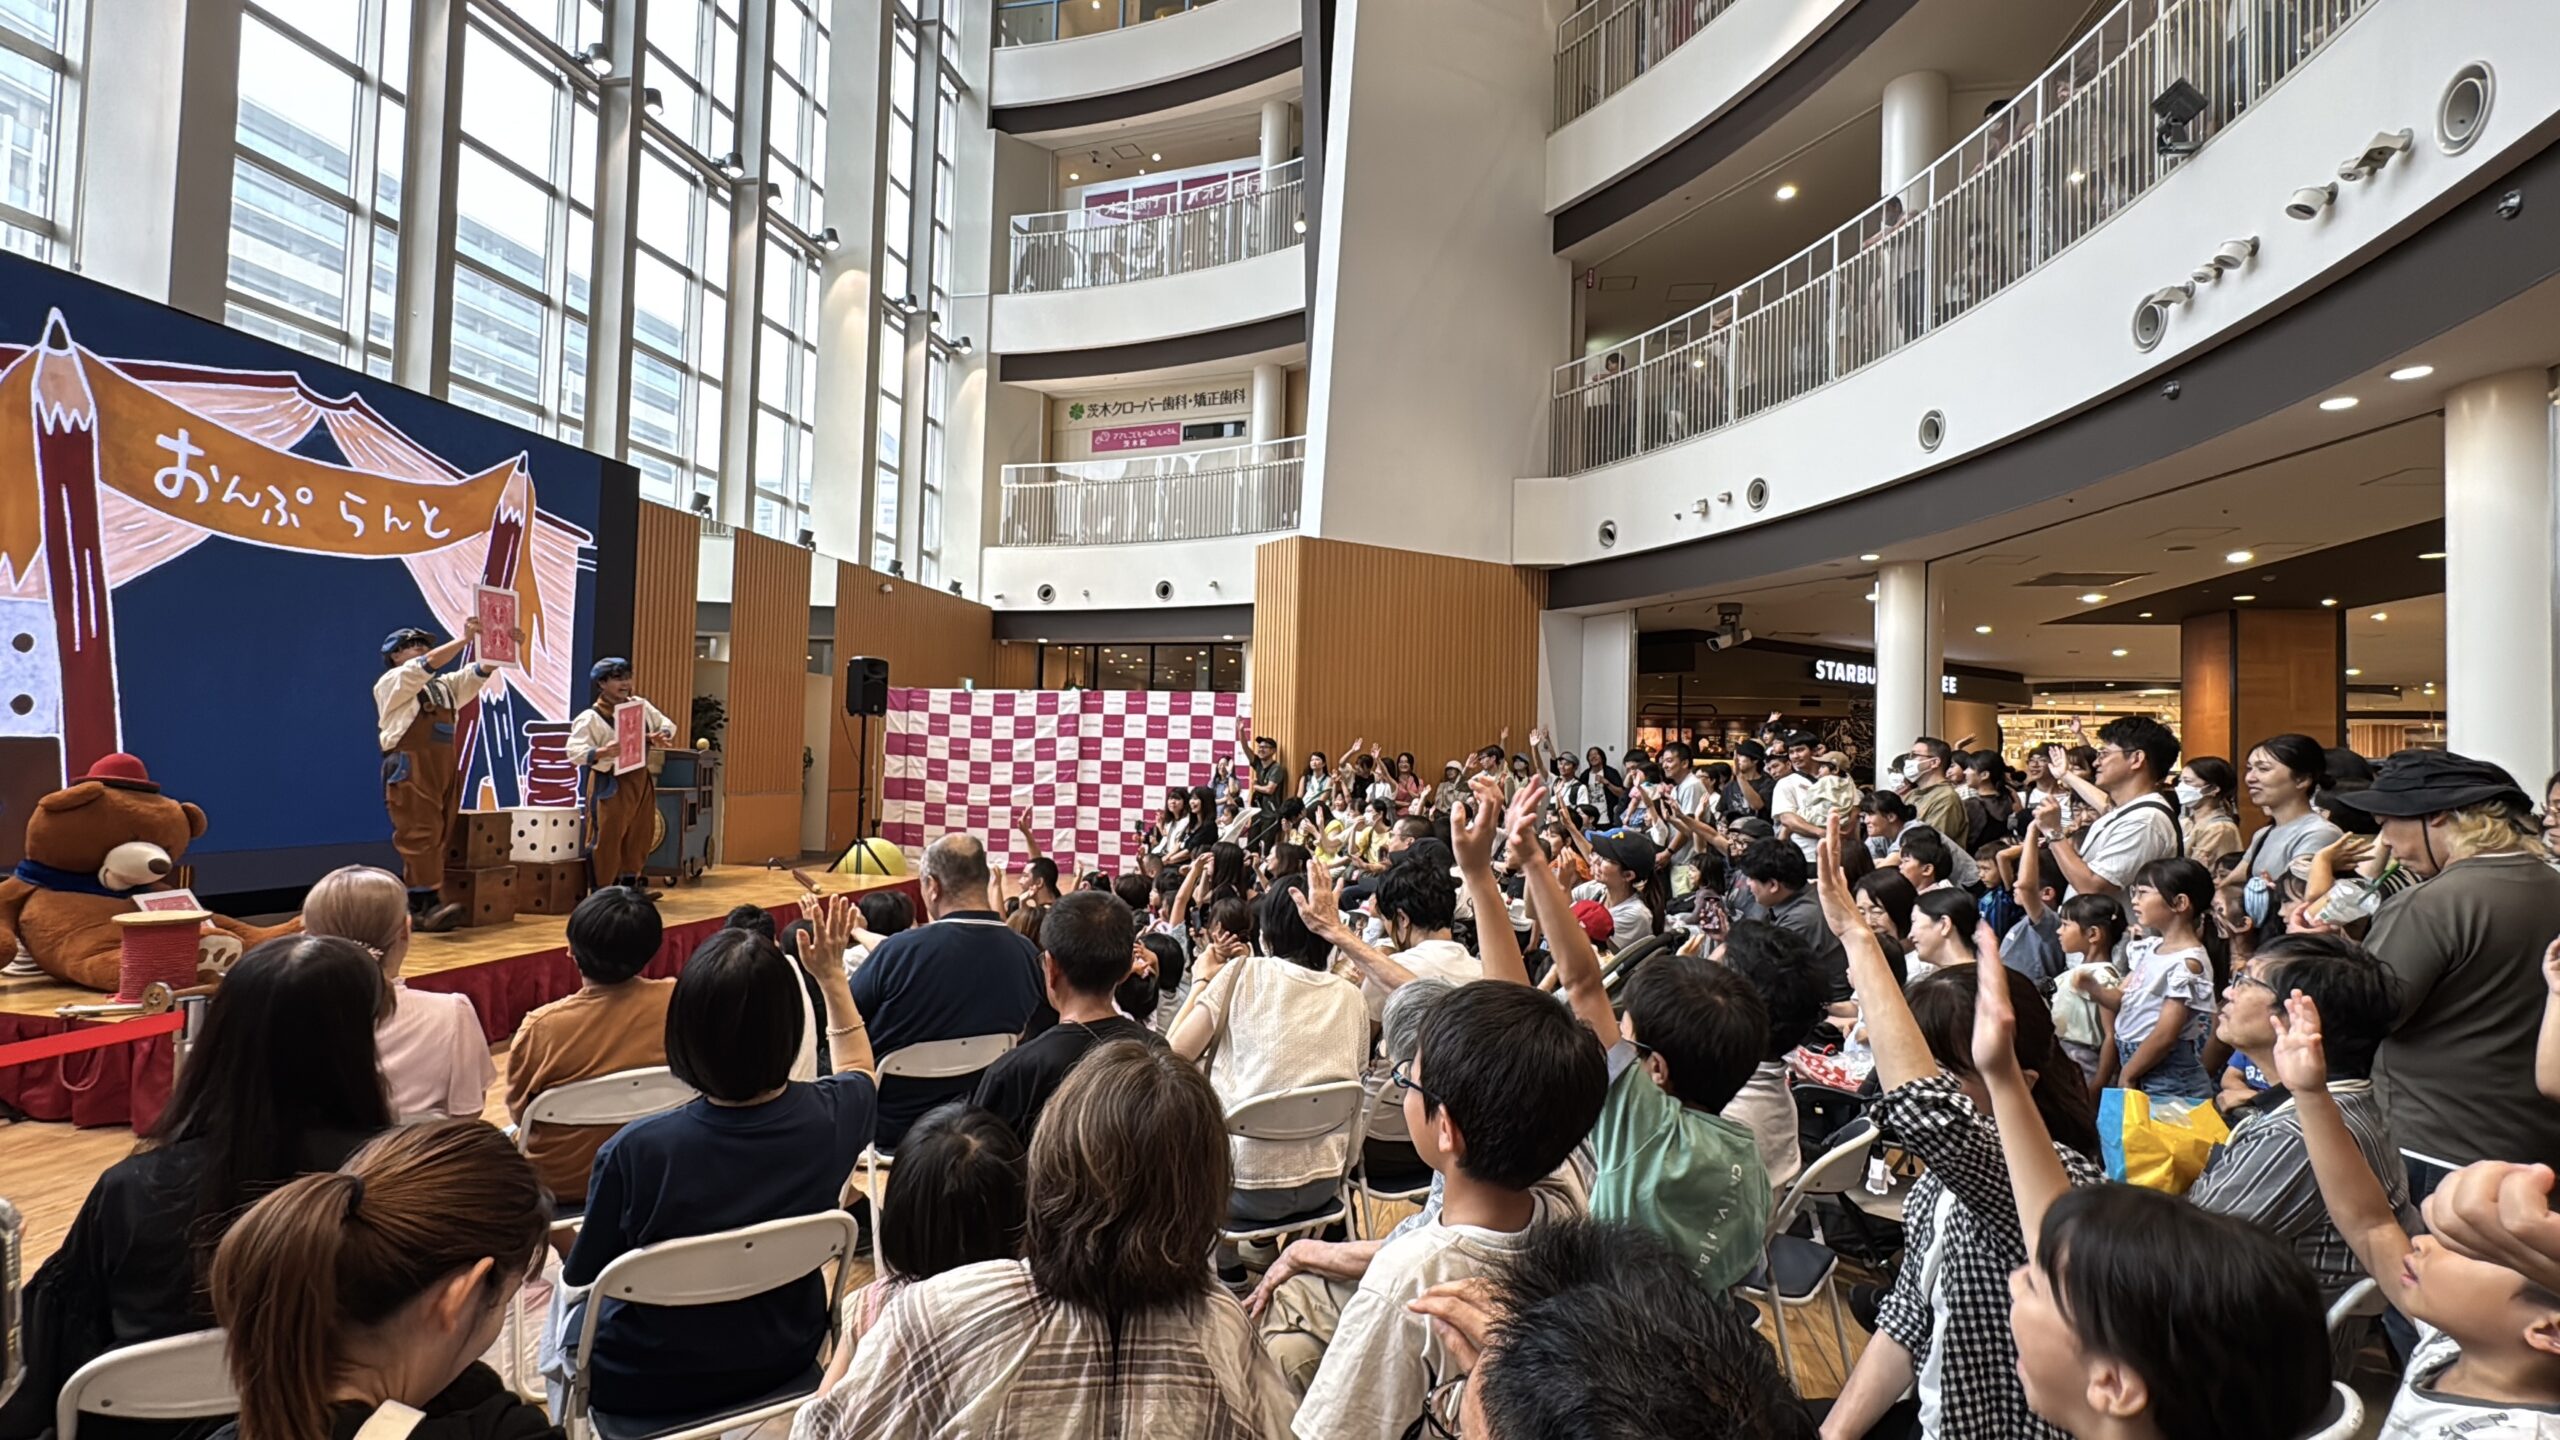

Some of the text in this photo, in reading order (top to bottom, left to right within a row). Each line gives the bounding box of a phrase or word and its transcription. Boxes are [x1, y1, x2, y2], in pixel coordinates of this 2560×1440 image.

[1087, 388, 1245, 419] 茨木クローバー歯科・矯正歯科
[1815, 659, 1877, 685] STARBU
